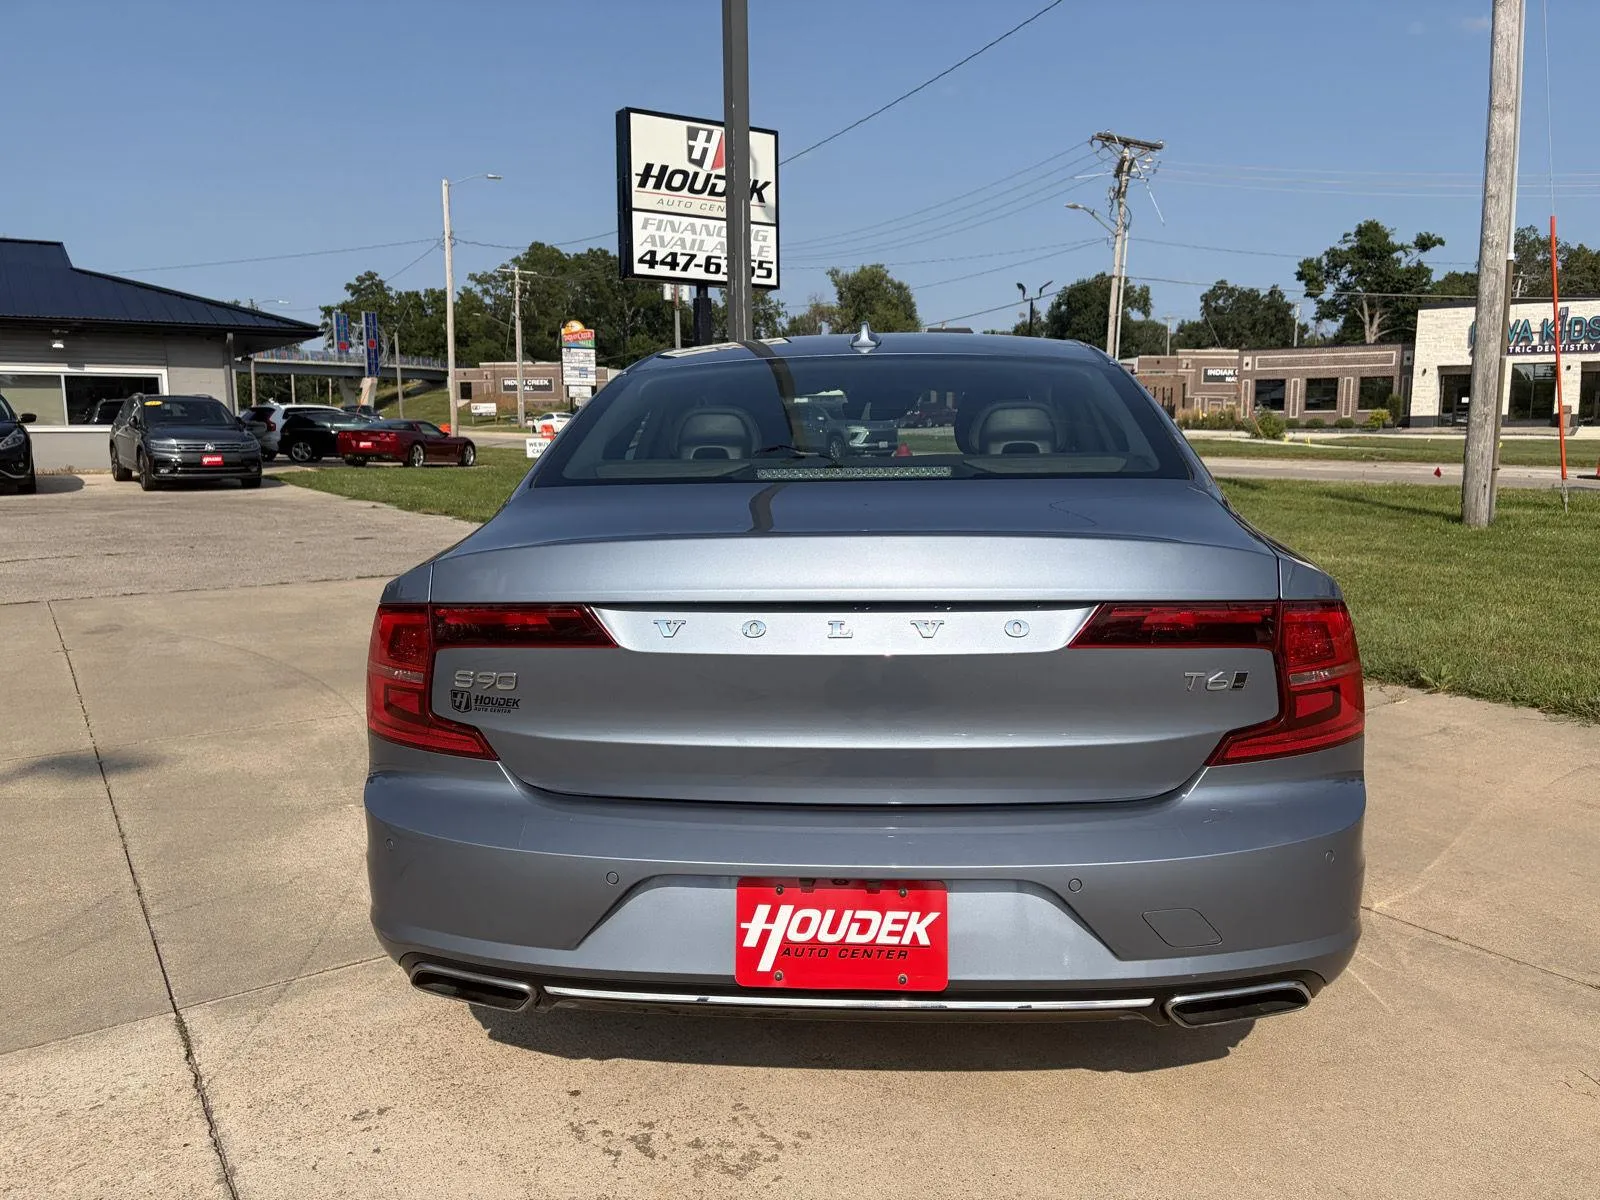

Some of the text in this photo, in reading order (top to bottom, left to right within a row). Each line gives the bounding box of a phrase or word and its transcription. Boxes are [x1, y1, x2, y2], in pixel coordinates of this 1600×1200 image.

[635, 162, 772, 204] HOUDK
[656, 198, 693, 209] AUTO
[641, 217, 769, 243] FINANCG
[640, 234, 772, 259] AVAILAE
[653, 619, 1031, 639] VOLVO
[454, 670, 517, 690] S90
[1184, 671, 1229, 691] T6
[473, 695, 520, 707] HOUDEK
[740, 904, 941, 972] HOUDEK
[781, 947, 908, 960] AUTO CENTER
